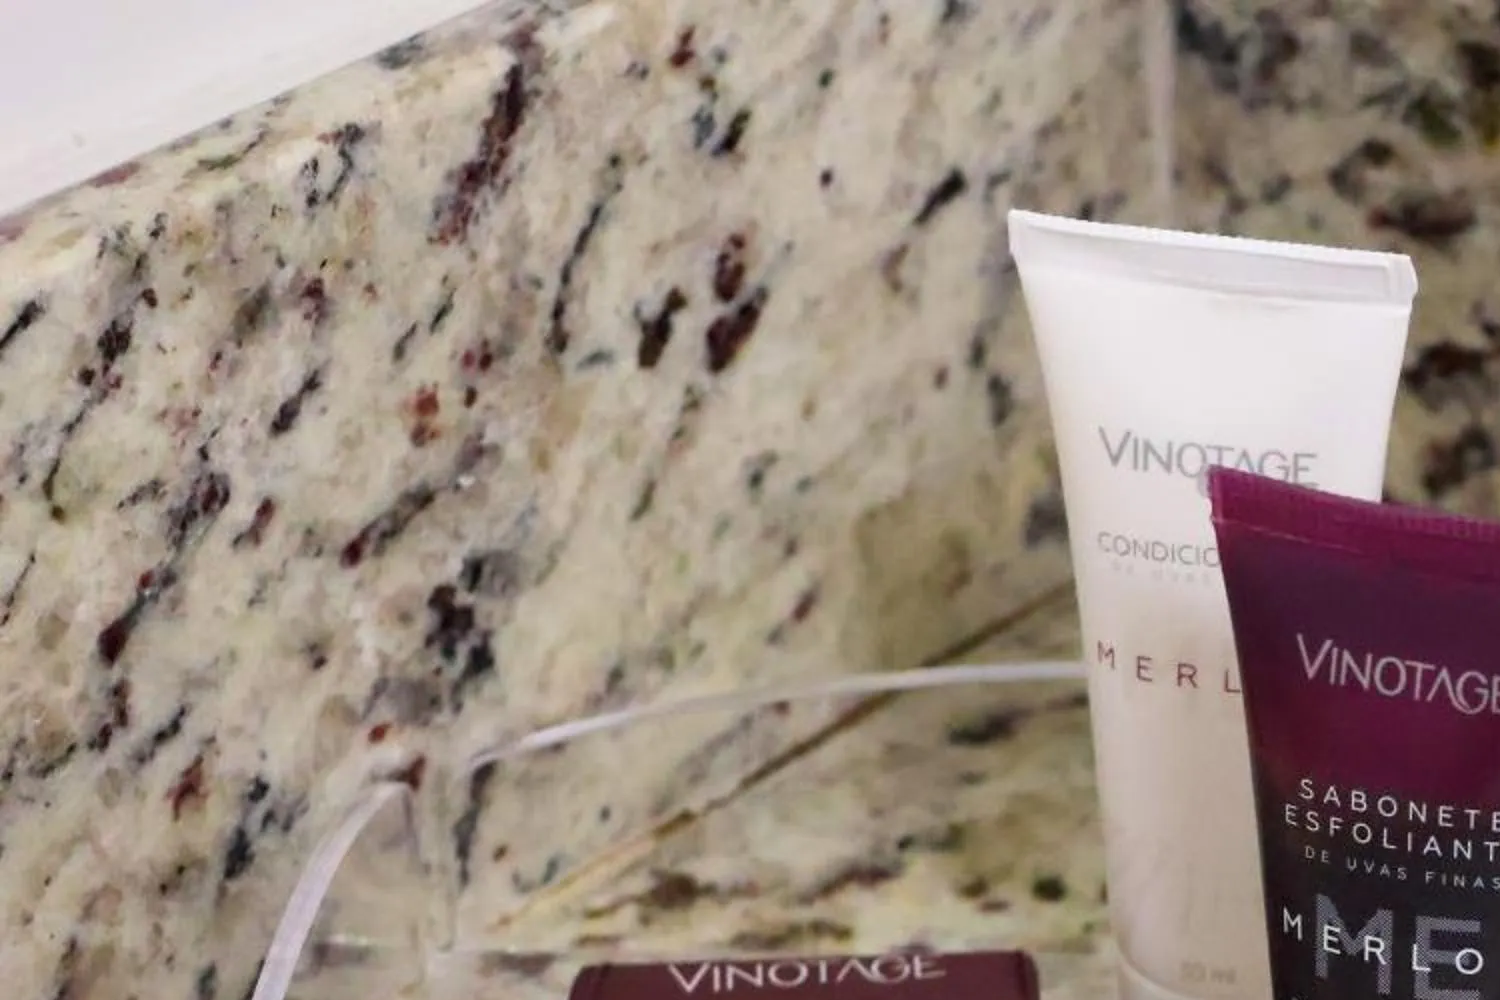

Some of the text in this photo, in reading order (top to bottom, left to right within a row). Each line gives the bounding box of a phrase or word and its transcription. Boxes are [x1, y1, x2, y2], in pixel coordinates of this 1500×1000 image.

[1097, 530, 1221, 567] CONDICIO
[1097, 639, 1241, 693] MERL
[1304, 846, 1331, 864] DE
[1347, 858, 1408, 882] UVAS
